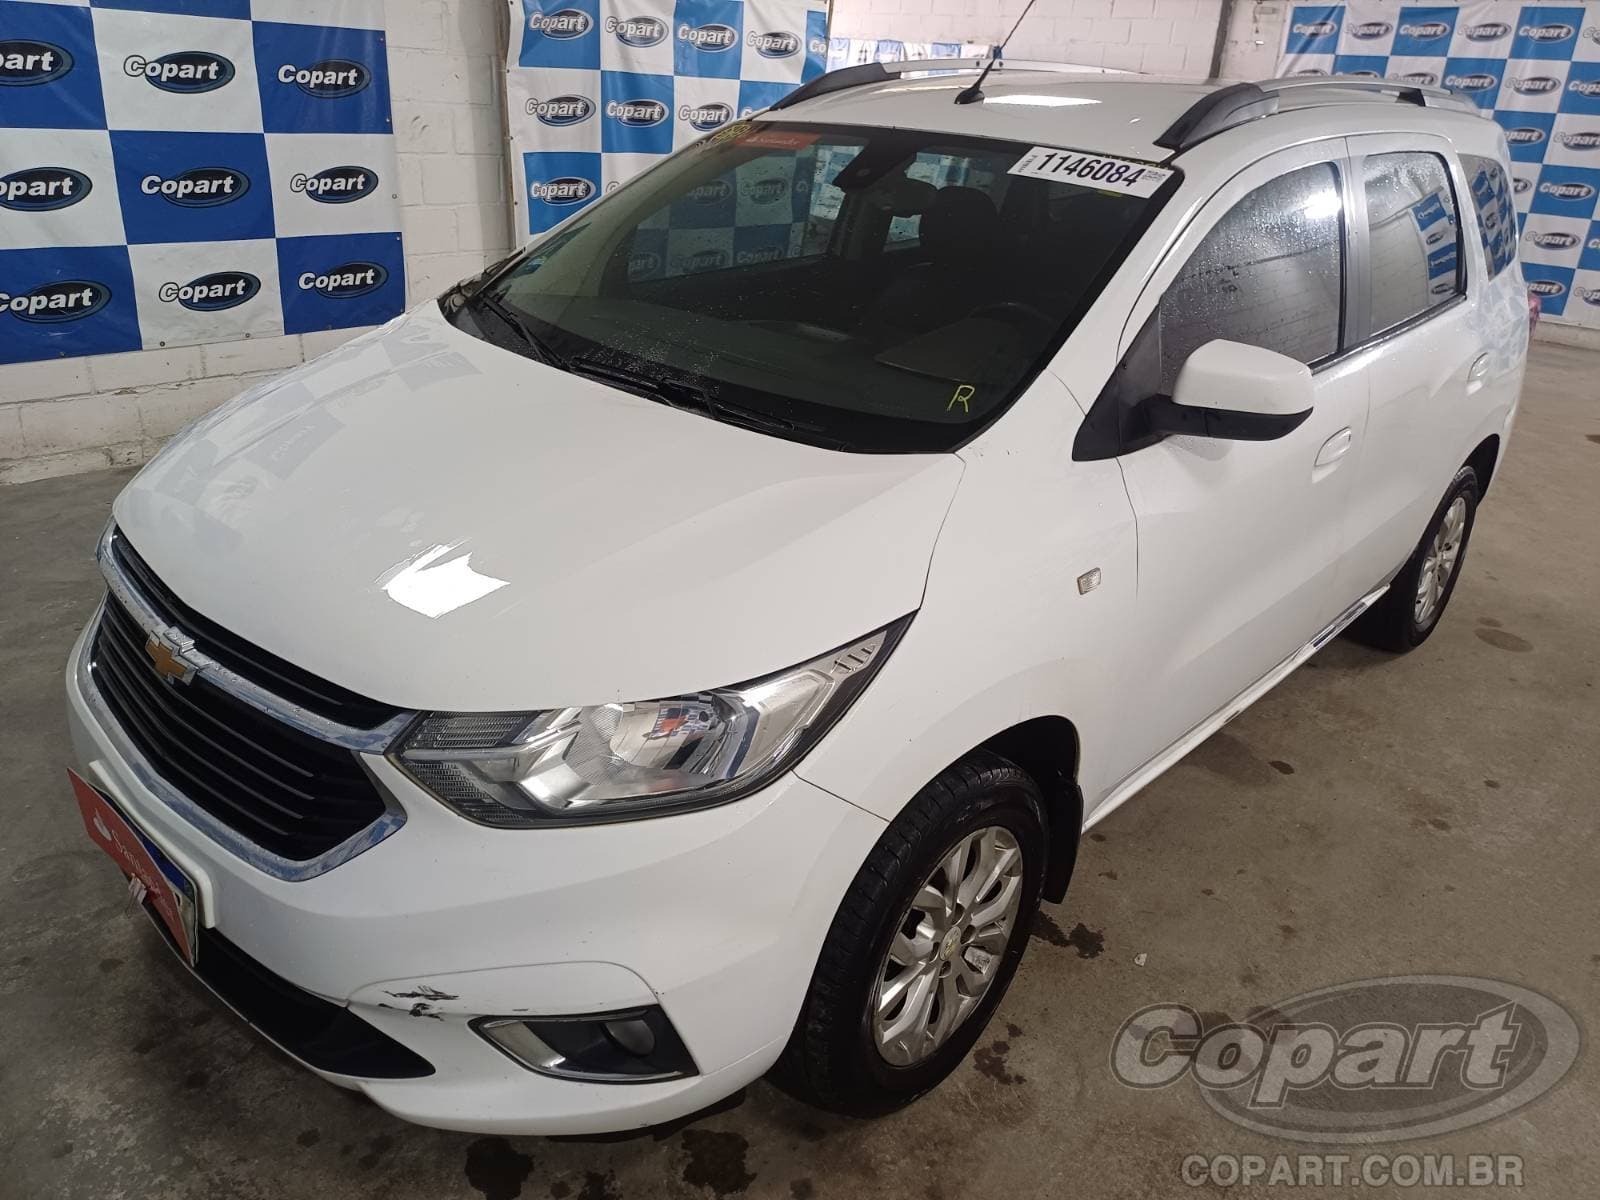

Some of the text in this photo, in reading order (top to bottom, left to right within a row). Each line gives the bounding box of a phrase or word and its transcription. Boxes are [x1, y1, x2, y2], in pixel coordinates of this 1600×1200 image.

[529, 13, 585, 33] Copart
[606, 16, 661, 37] Copart
[1400, 22, 1447, 37] Copart
[1519, 25, 1568, 38] Copart
[678, 25, 731, 45] Copart
[746, 31, 797, 51] Copart
[0, 51, 54, 72] art
[124, 56, 220, 80] Copart
[277, 64, 358, 86] Copart
[1445, 75, 1491, 88] Copart
[526, 97, 585, 117] Copart
[607, 101, 662, 120] Copart
[679, 106, 727, 124] Copart
[1037, 152, 1146, 187] 1146084
[141, 174, 234, 198] Copart
[290, 171, 365, 193] Copart
[530, 180, 587, 199] Copart
[1540, 182, 1590, 197] Copart
[1525, 231, 1574, 247] Copart
[159, 281, 246, 302] Copart
[298, 271, 375, 293] Copart
[946, 385, 975, 413] R
